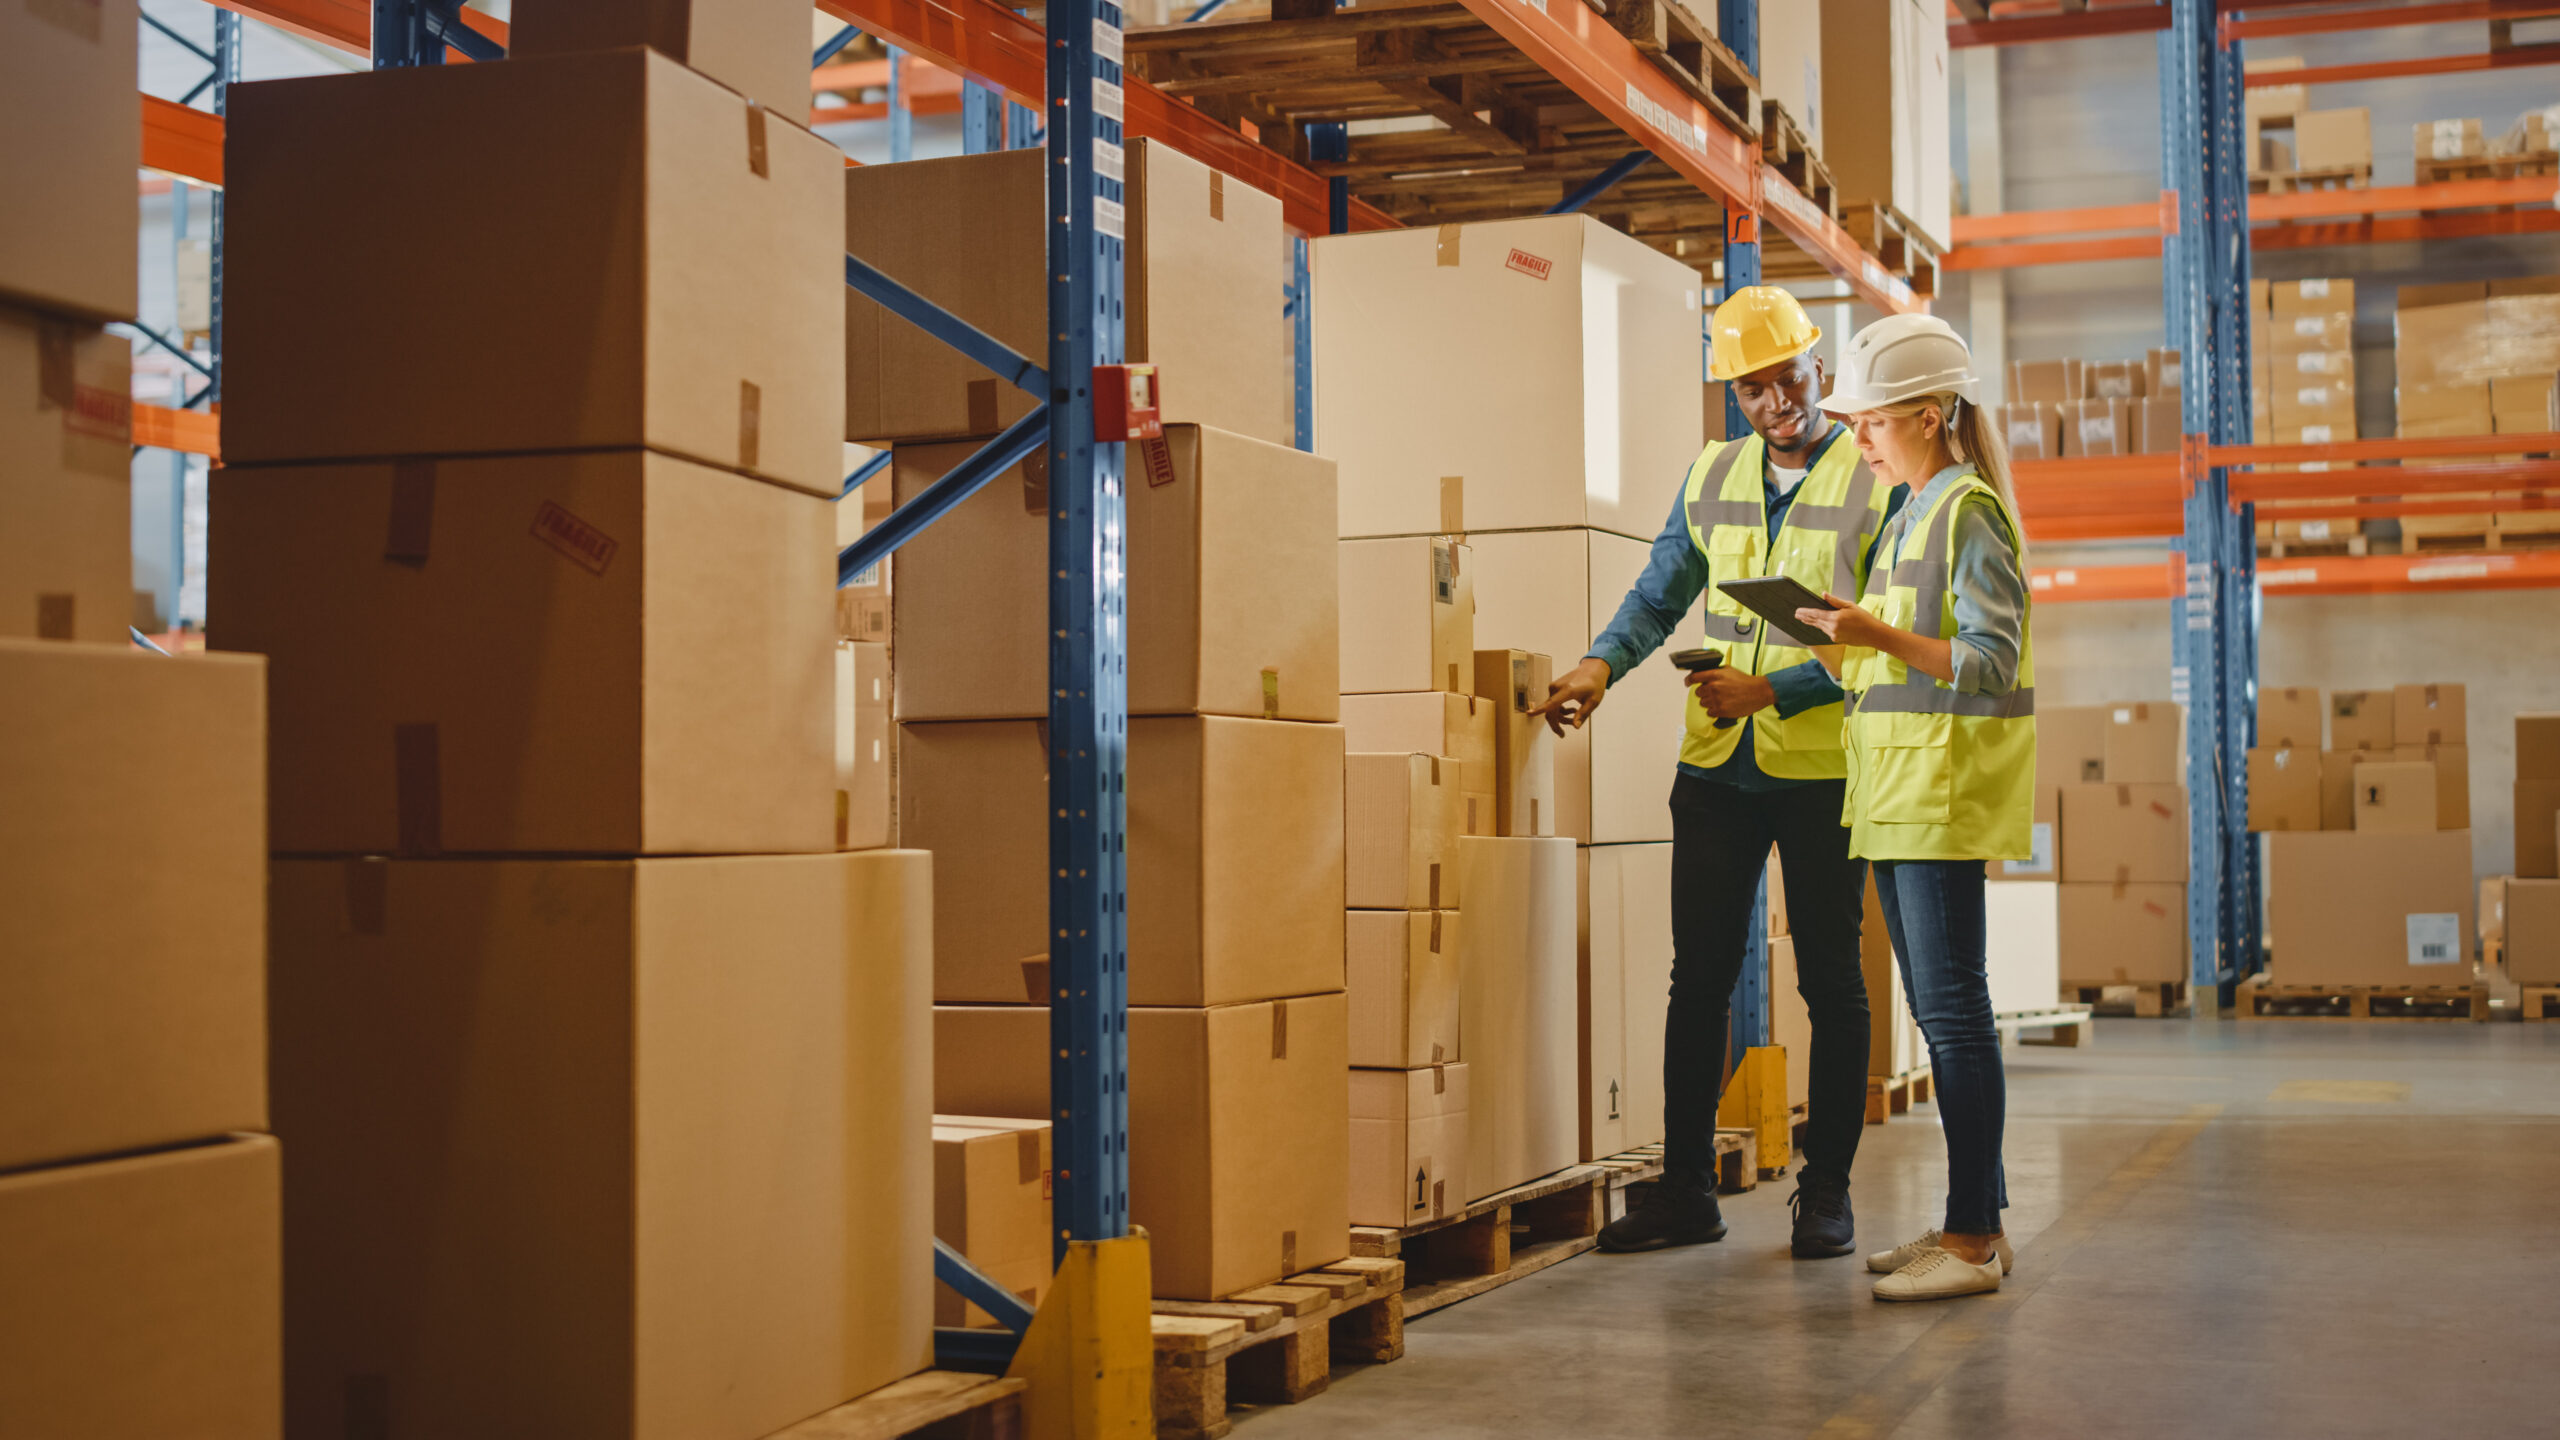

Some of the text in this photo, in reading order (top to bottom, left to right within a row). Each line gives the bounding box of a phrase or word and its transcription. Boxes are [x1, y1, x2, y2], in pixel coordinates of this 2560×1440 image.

[1510, 251, 1549, 274] FRAGILE
[1150, 438, 1170, 481] AGILE
[540, 508, 609, 563] FRAGILE
